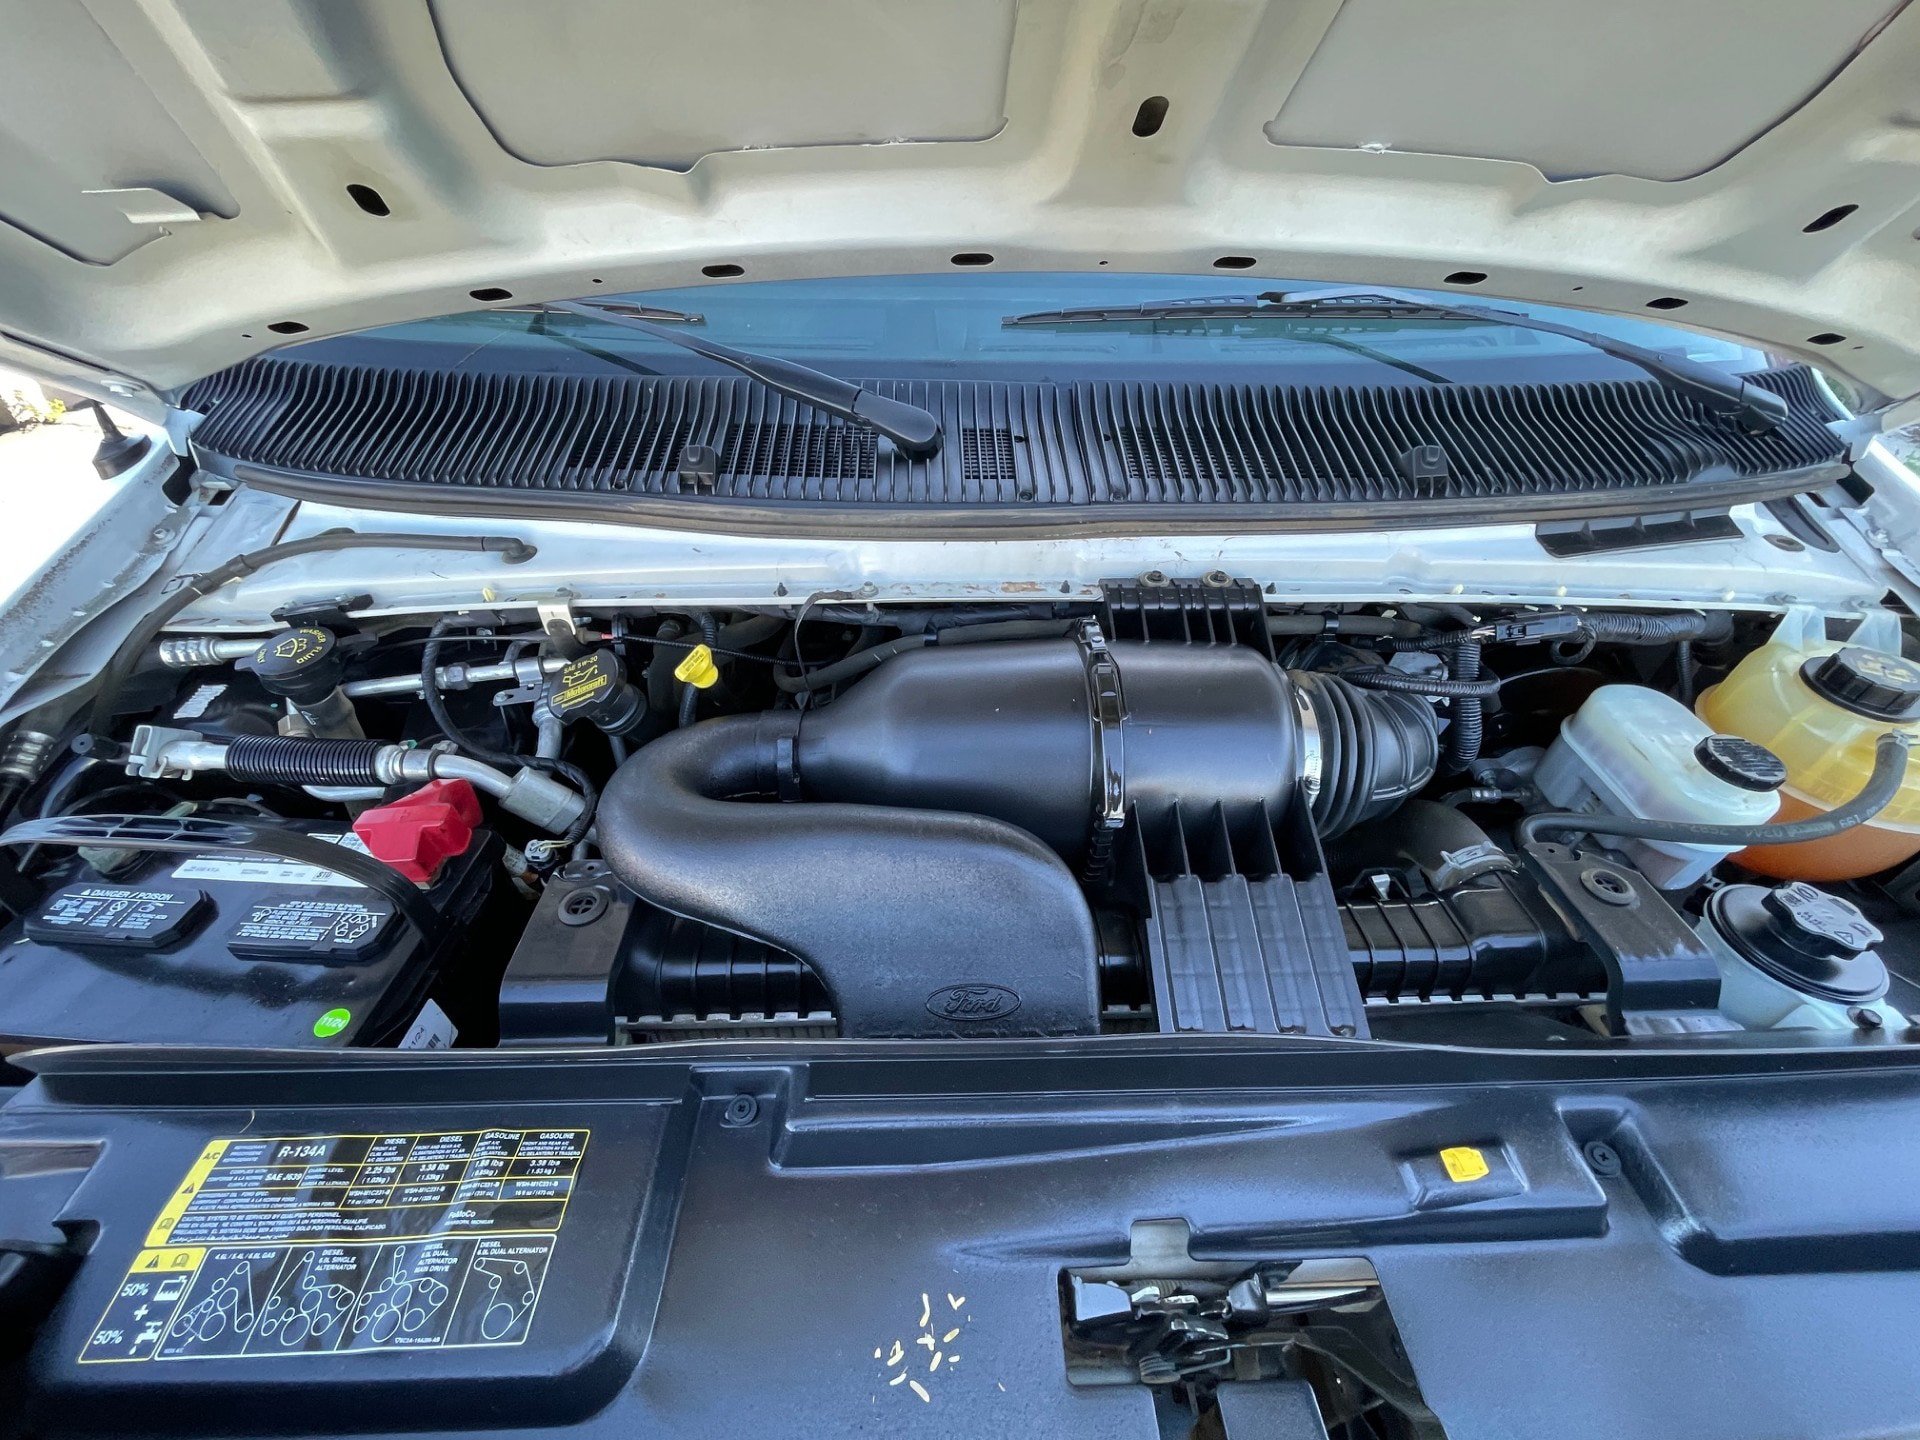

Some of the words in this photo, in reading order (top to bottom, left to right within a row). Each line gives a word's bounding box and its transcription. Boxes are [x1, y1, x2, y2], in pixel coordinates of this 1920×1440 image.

[90, 889, 130, 898] DANGER
[139, 892, 175, 901] POISON
[944, 988, 1003, 1014] Ford
[439, 1135, 463, 1143] DIESEL
[485, 1132, 521, 1140] GASOLINE
[540, 1132, 575, 1140] GASOLINE
[204, 1152, 221, 1160] A/C
[277, 1144, 327, 1158] R-134A
[365, 1166, 383, 1174] 2.25
[121, 1282, 150, 1297] 50%
[92, 1329, 124, 1345] 50%
